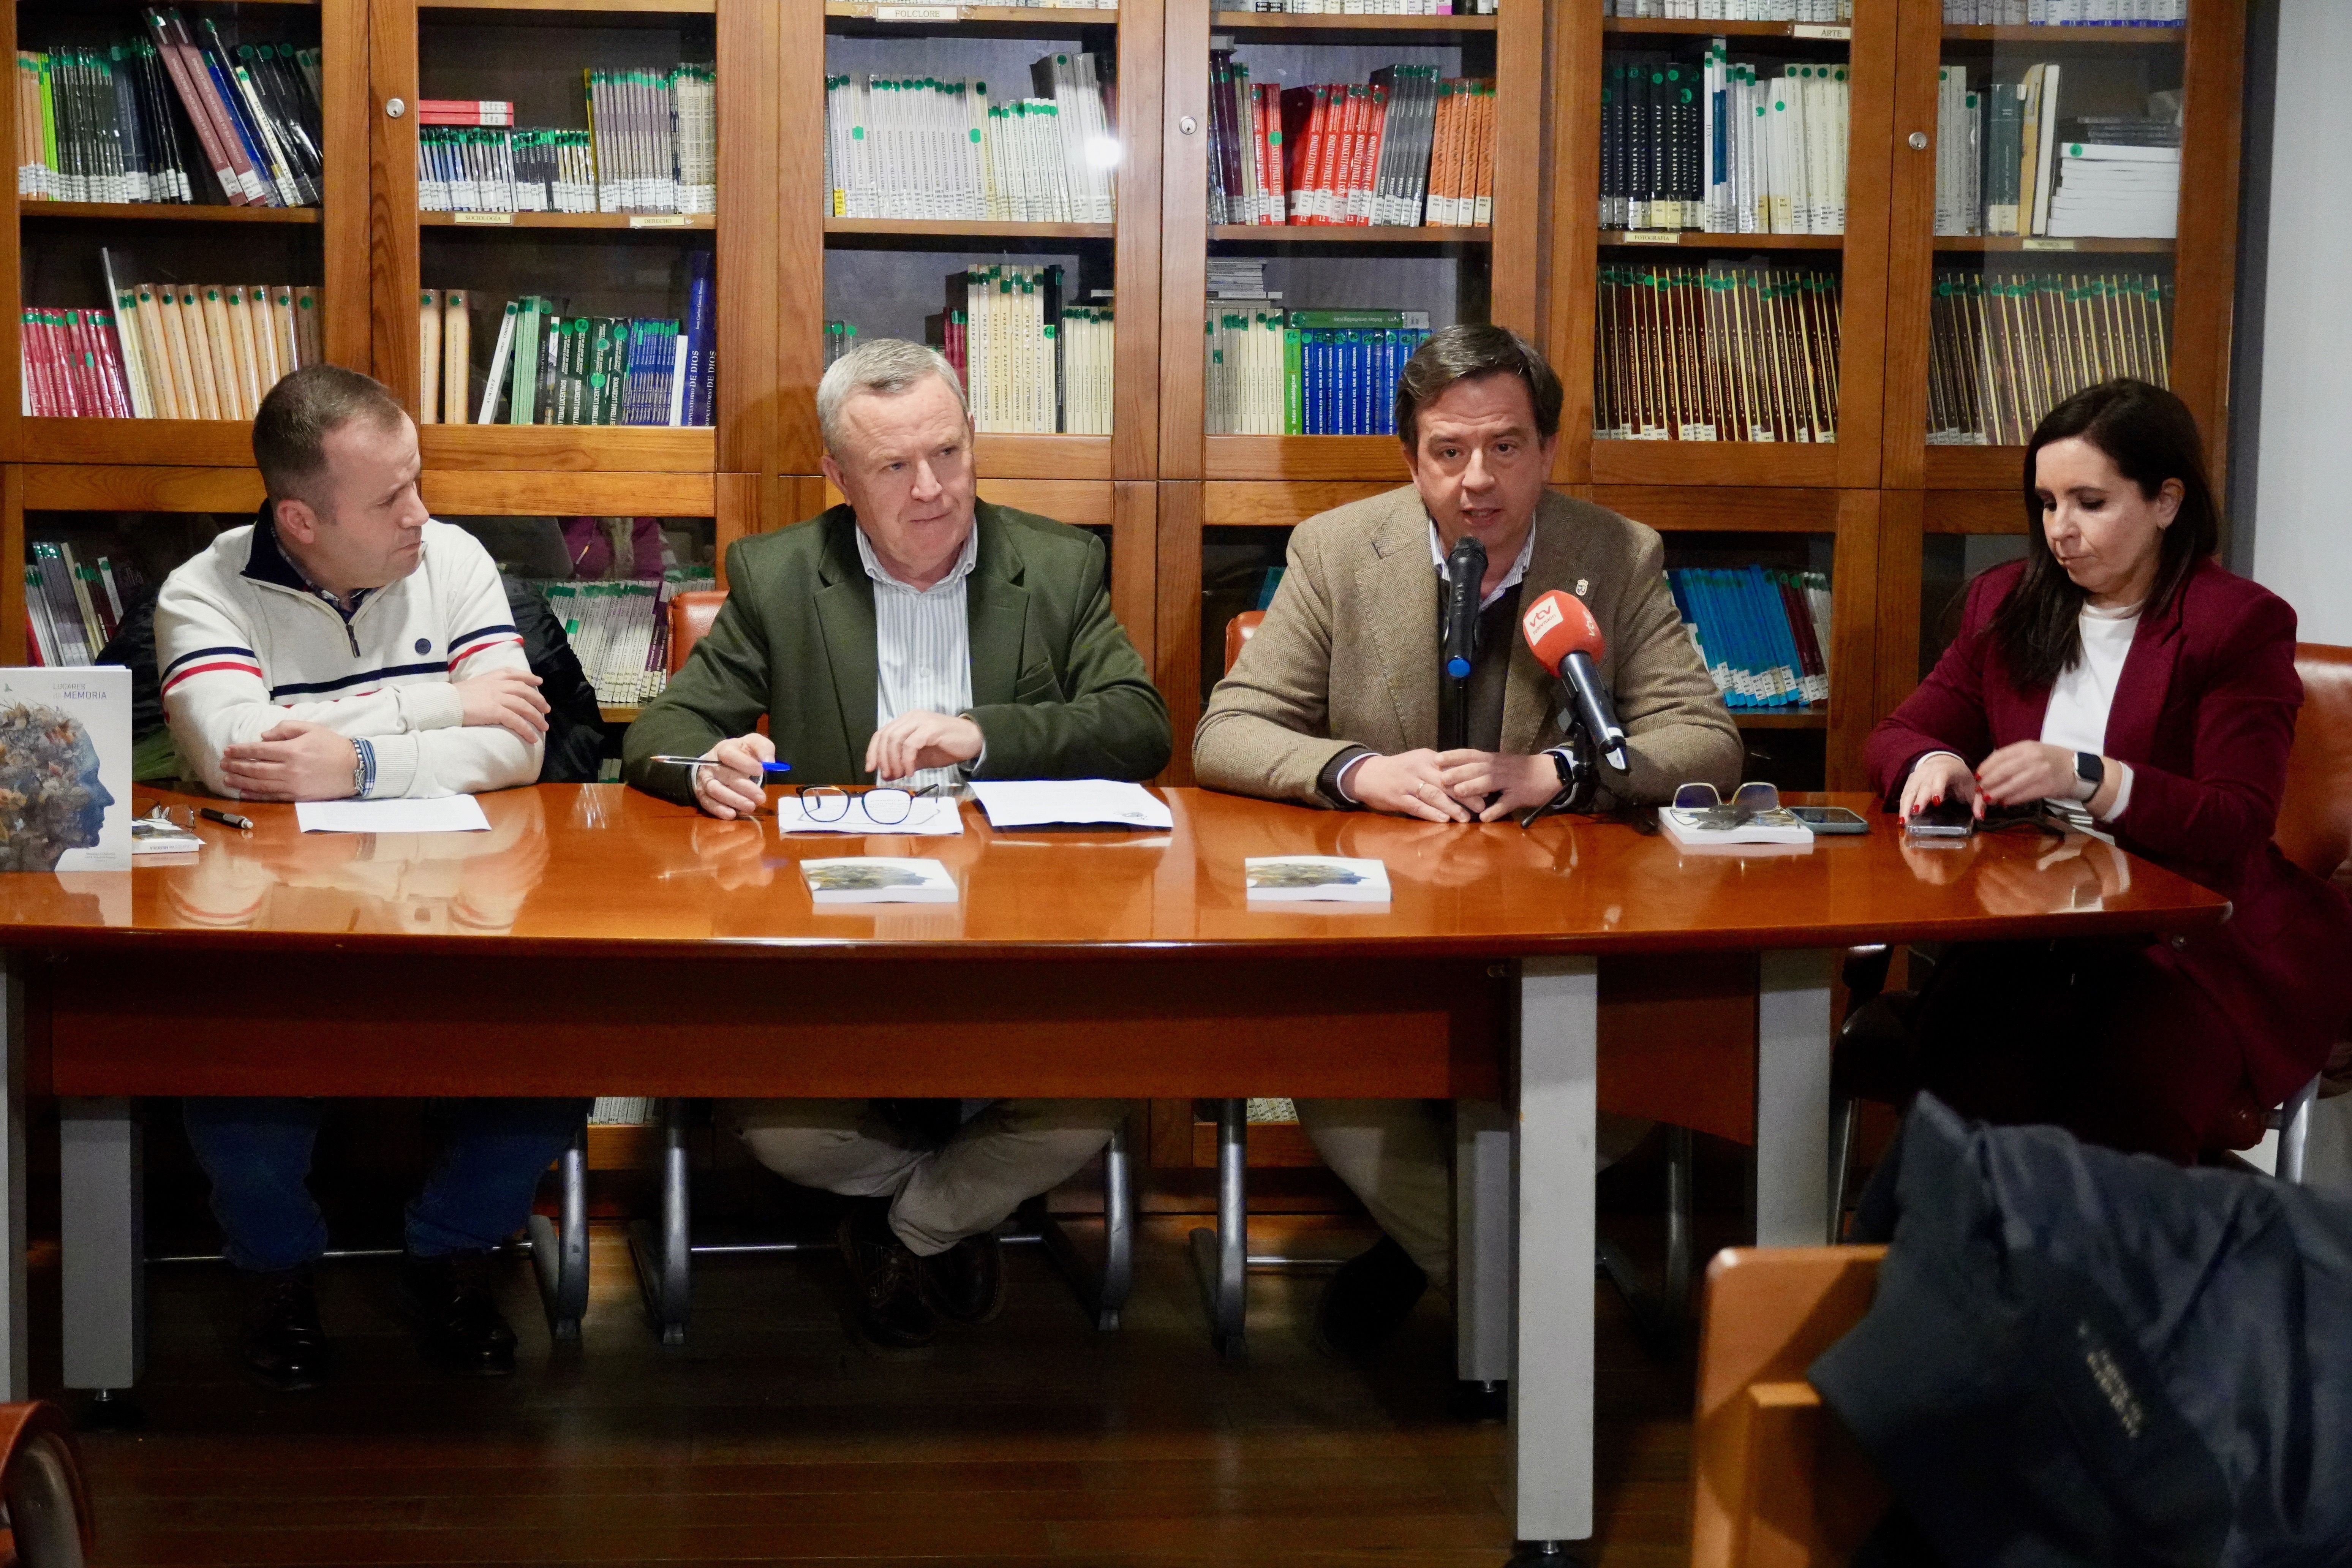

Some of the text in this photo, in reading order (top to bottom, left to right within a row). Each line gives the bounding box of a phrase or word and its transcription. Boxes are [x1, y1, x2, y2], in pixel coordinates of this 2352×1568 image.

[1307, 134, 1319, 164] LUCENTINOS
[1325, 134, 1336, 163] LUCENTINOS
[1341, 134, 1351, 163] LUCENTINOS
[1354, 134, 1365, 163] LUCENTINOS
[1306, 165, 1315, 179] TEMAS
[1323, 164, 1332, 179] TEMAS
[1338, 164, 1347, 179] TEMAS
[1352, 164, 1361, 179] TEMAS
[689, 375, 697, 387] DE
[707, 376, 714, 387] DE
[1530, 605, 1551, 627] vtv
